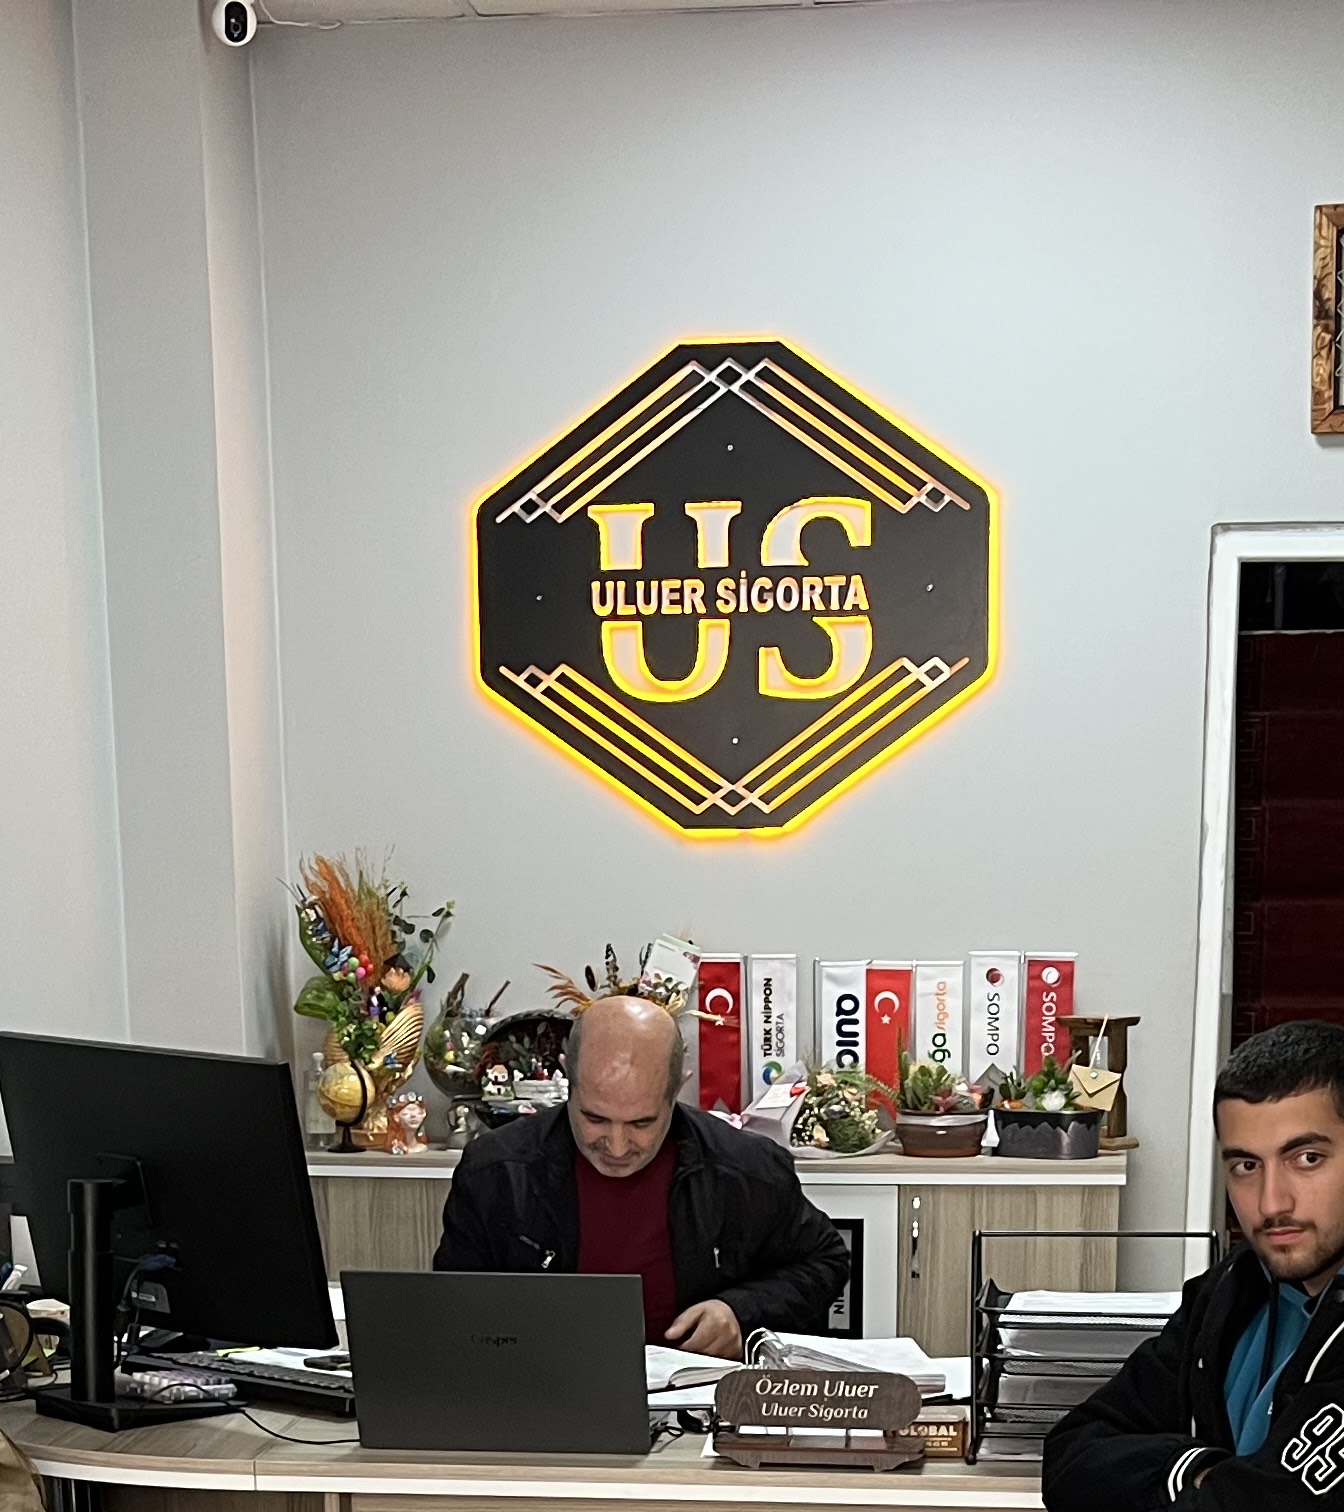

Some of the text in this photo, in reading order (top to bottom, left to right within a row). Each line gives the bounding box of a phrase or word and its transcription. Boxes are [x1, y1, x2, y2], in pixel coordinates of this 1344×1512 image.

[588, 497, 872, 702] US
[590, 569, 870, 616] ULUER SİGORTA
[761, 1028, 772, 1057] TÜRK
[986, 992, 1000, 1056] SOMPO
[1040, 991, 1057, 1056] SOMPO
[755, 1373, 880, 1398] Özlem Uluer
[761, 1402, 869, 1422] Uluer Sigorta
